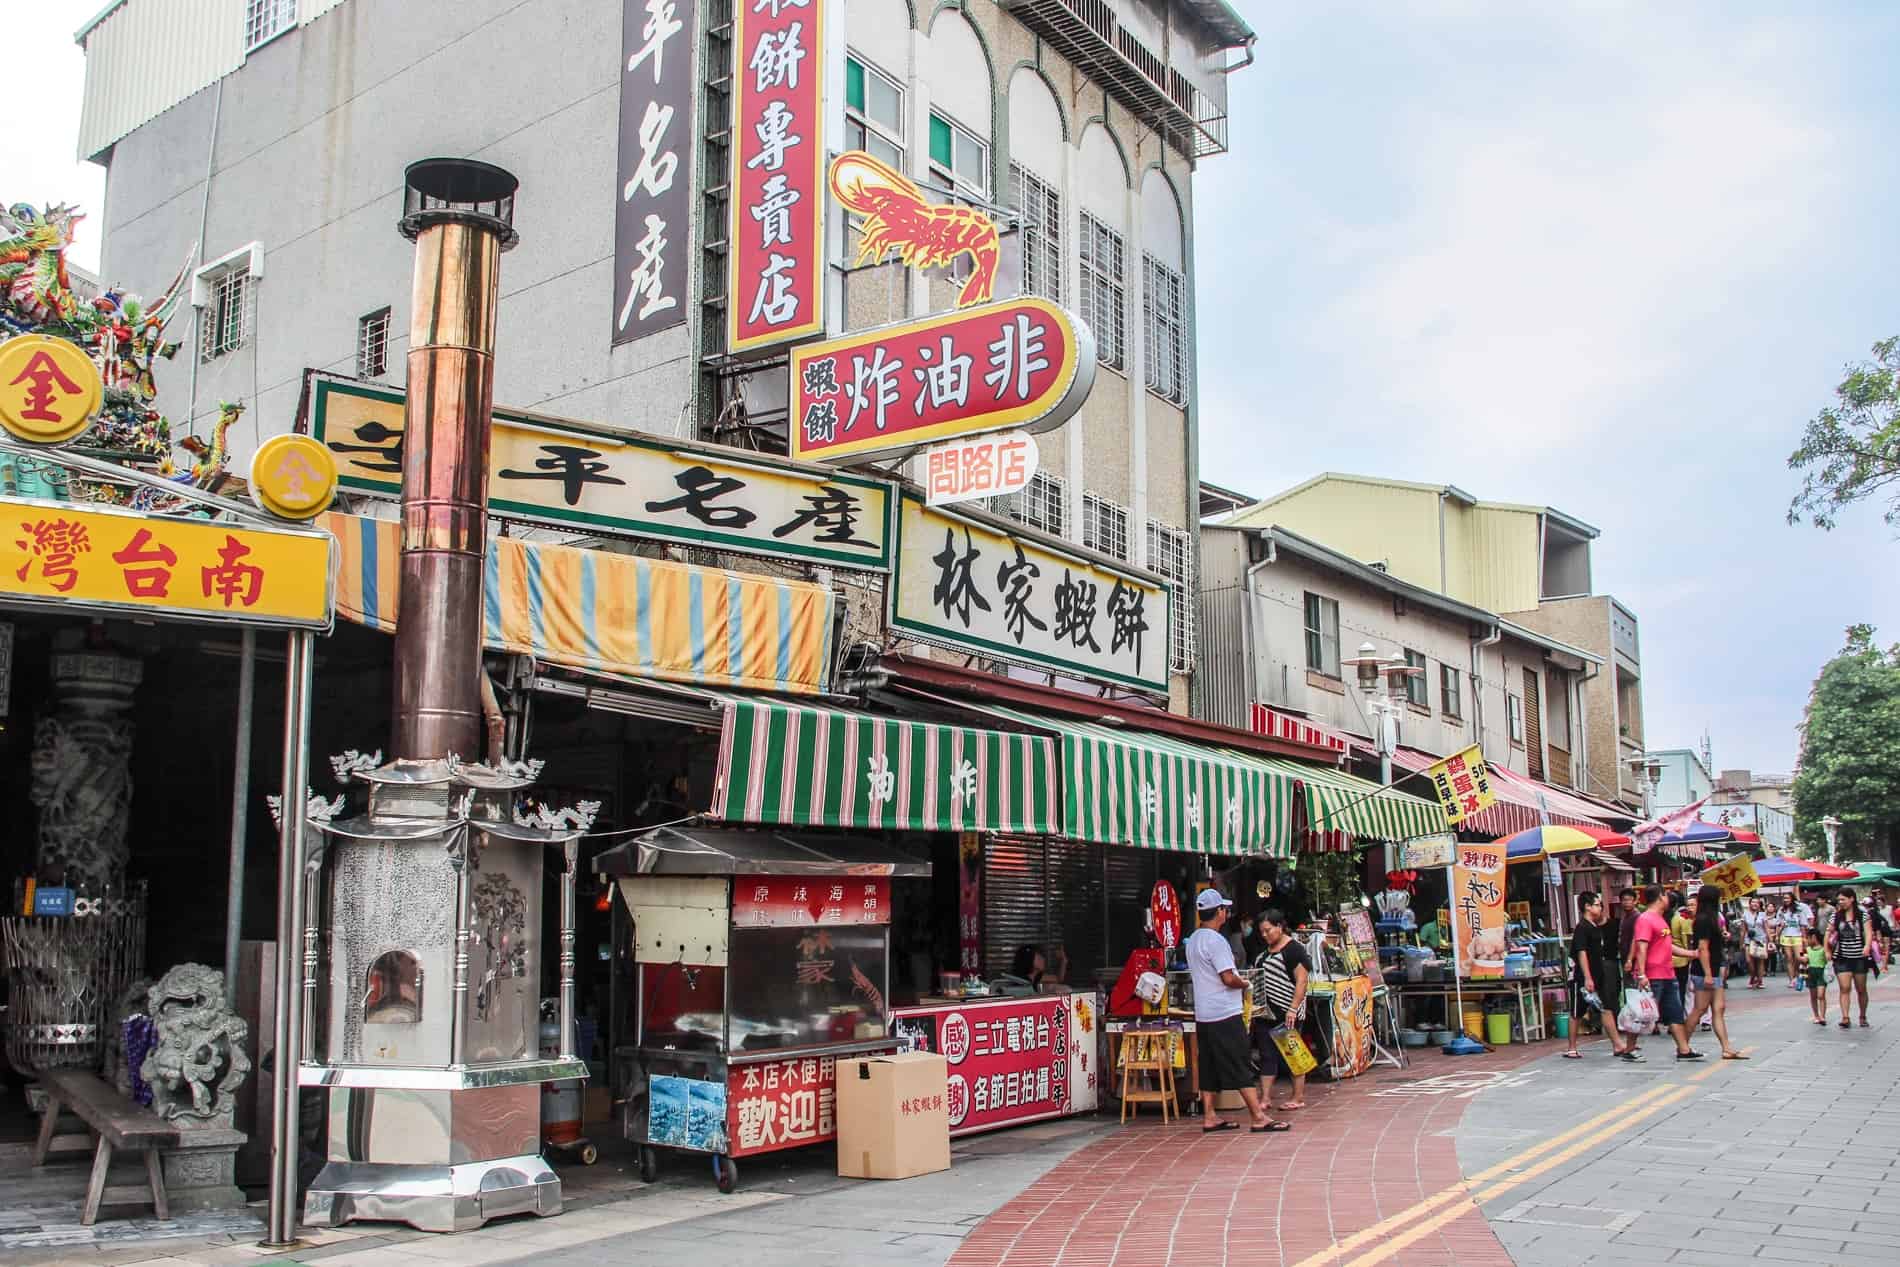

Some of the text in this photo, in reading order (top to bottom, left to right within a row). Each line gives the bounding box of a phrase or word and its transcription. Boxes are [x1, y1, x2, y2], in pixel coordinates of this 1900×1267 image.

[9, 350, 84, 424] 金
[802, 358, 839, 443] 蝦餅
[272, 449, 325, 502] 金
[928, 440, 1027, 499] 問路店
[932, 524, 1150, 677] 林家蝦餅
[974, 1014, 1050, 1057] 三立電視台
[1052, 1004, 1066, 1107] 老店30年
[901, 1094, 943, 1117] 林家蝦餅
[973, 1066, 1050, 1113] 各節目拍攝
